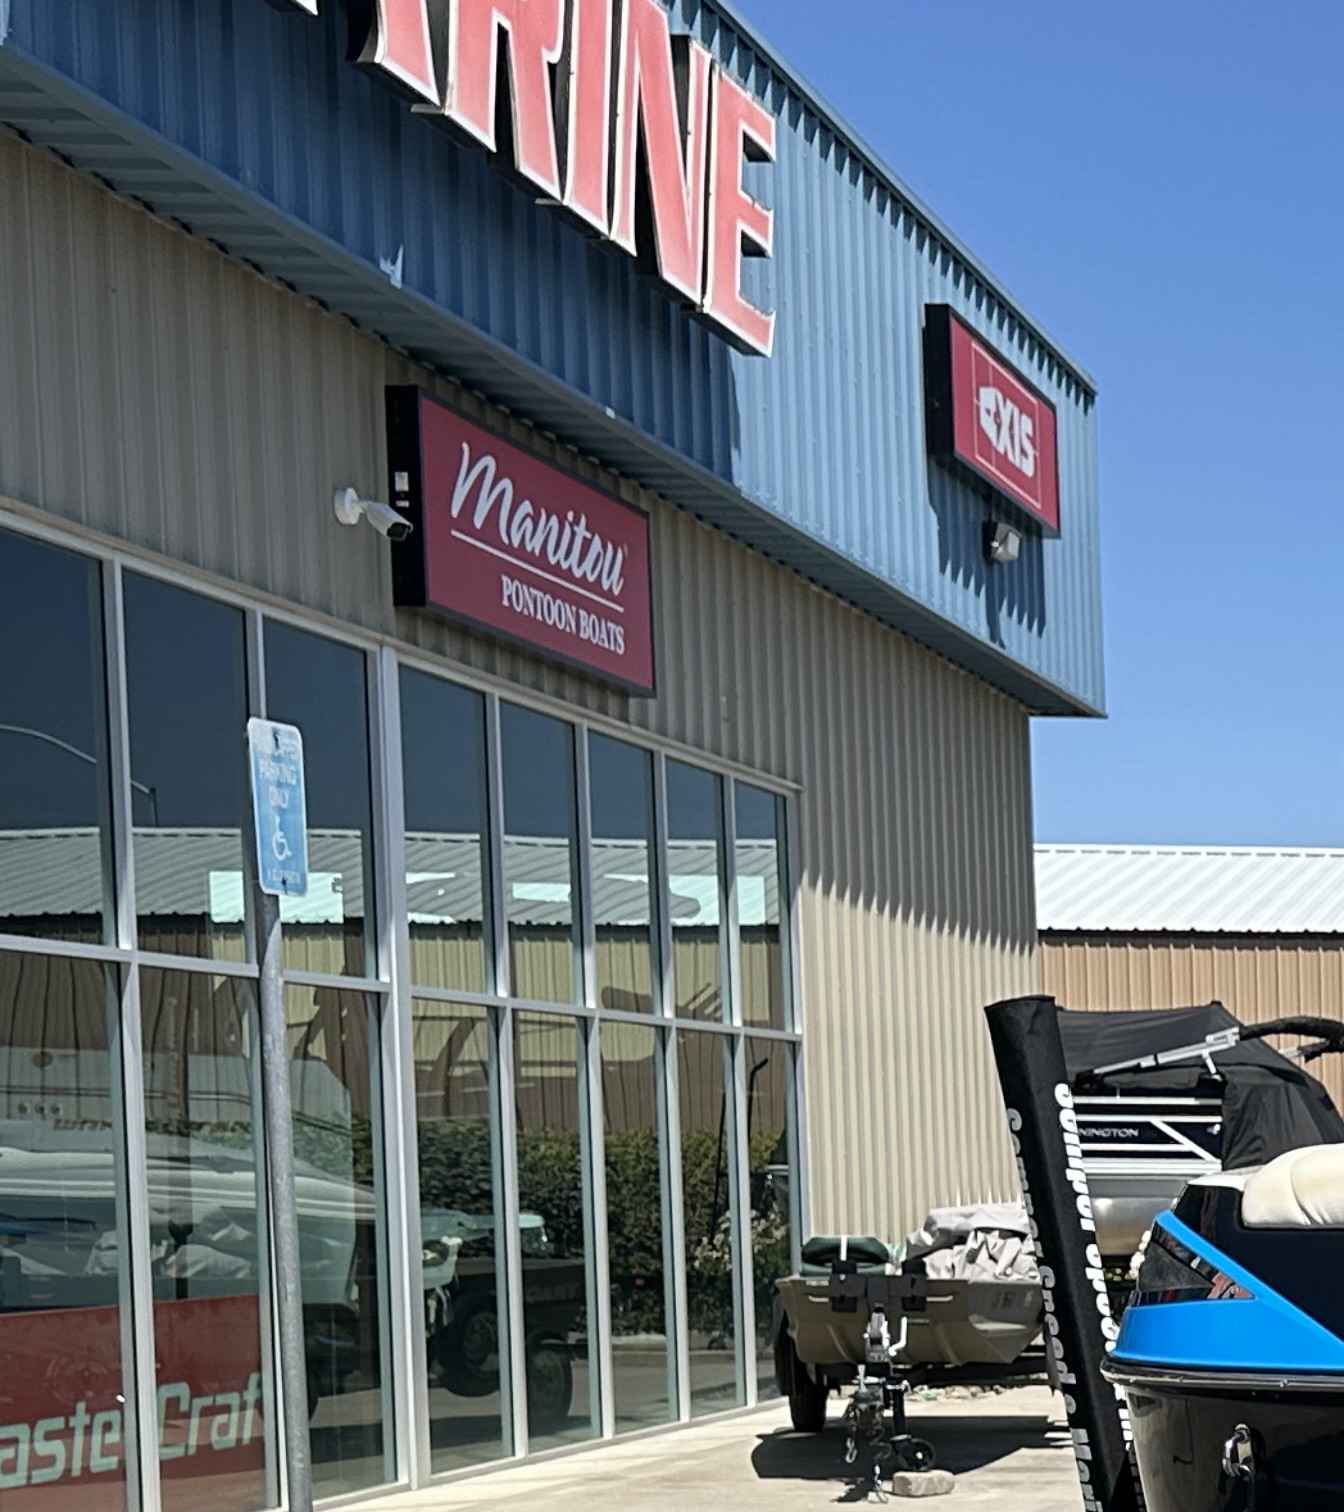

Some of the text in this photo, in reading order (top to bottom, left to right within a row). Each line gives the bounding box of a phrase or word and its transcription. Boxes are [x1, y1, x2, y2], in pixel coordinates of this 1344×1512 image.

[293, 0, 776, 357] RINE
[451, 441, 625, 597] Manitou
[501, 574, 625, 656] PONTOON BOATS
[0, 1371, 264, 1489] asteCraf
